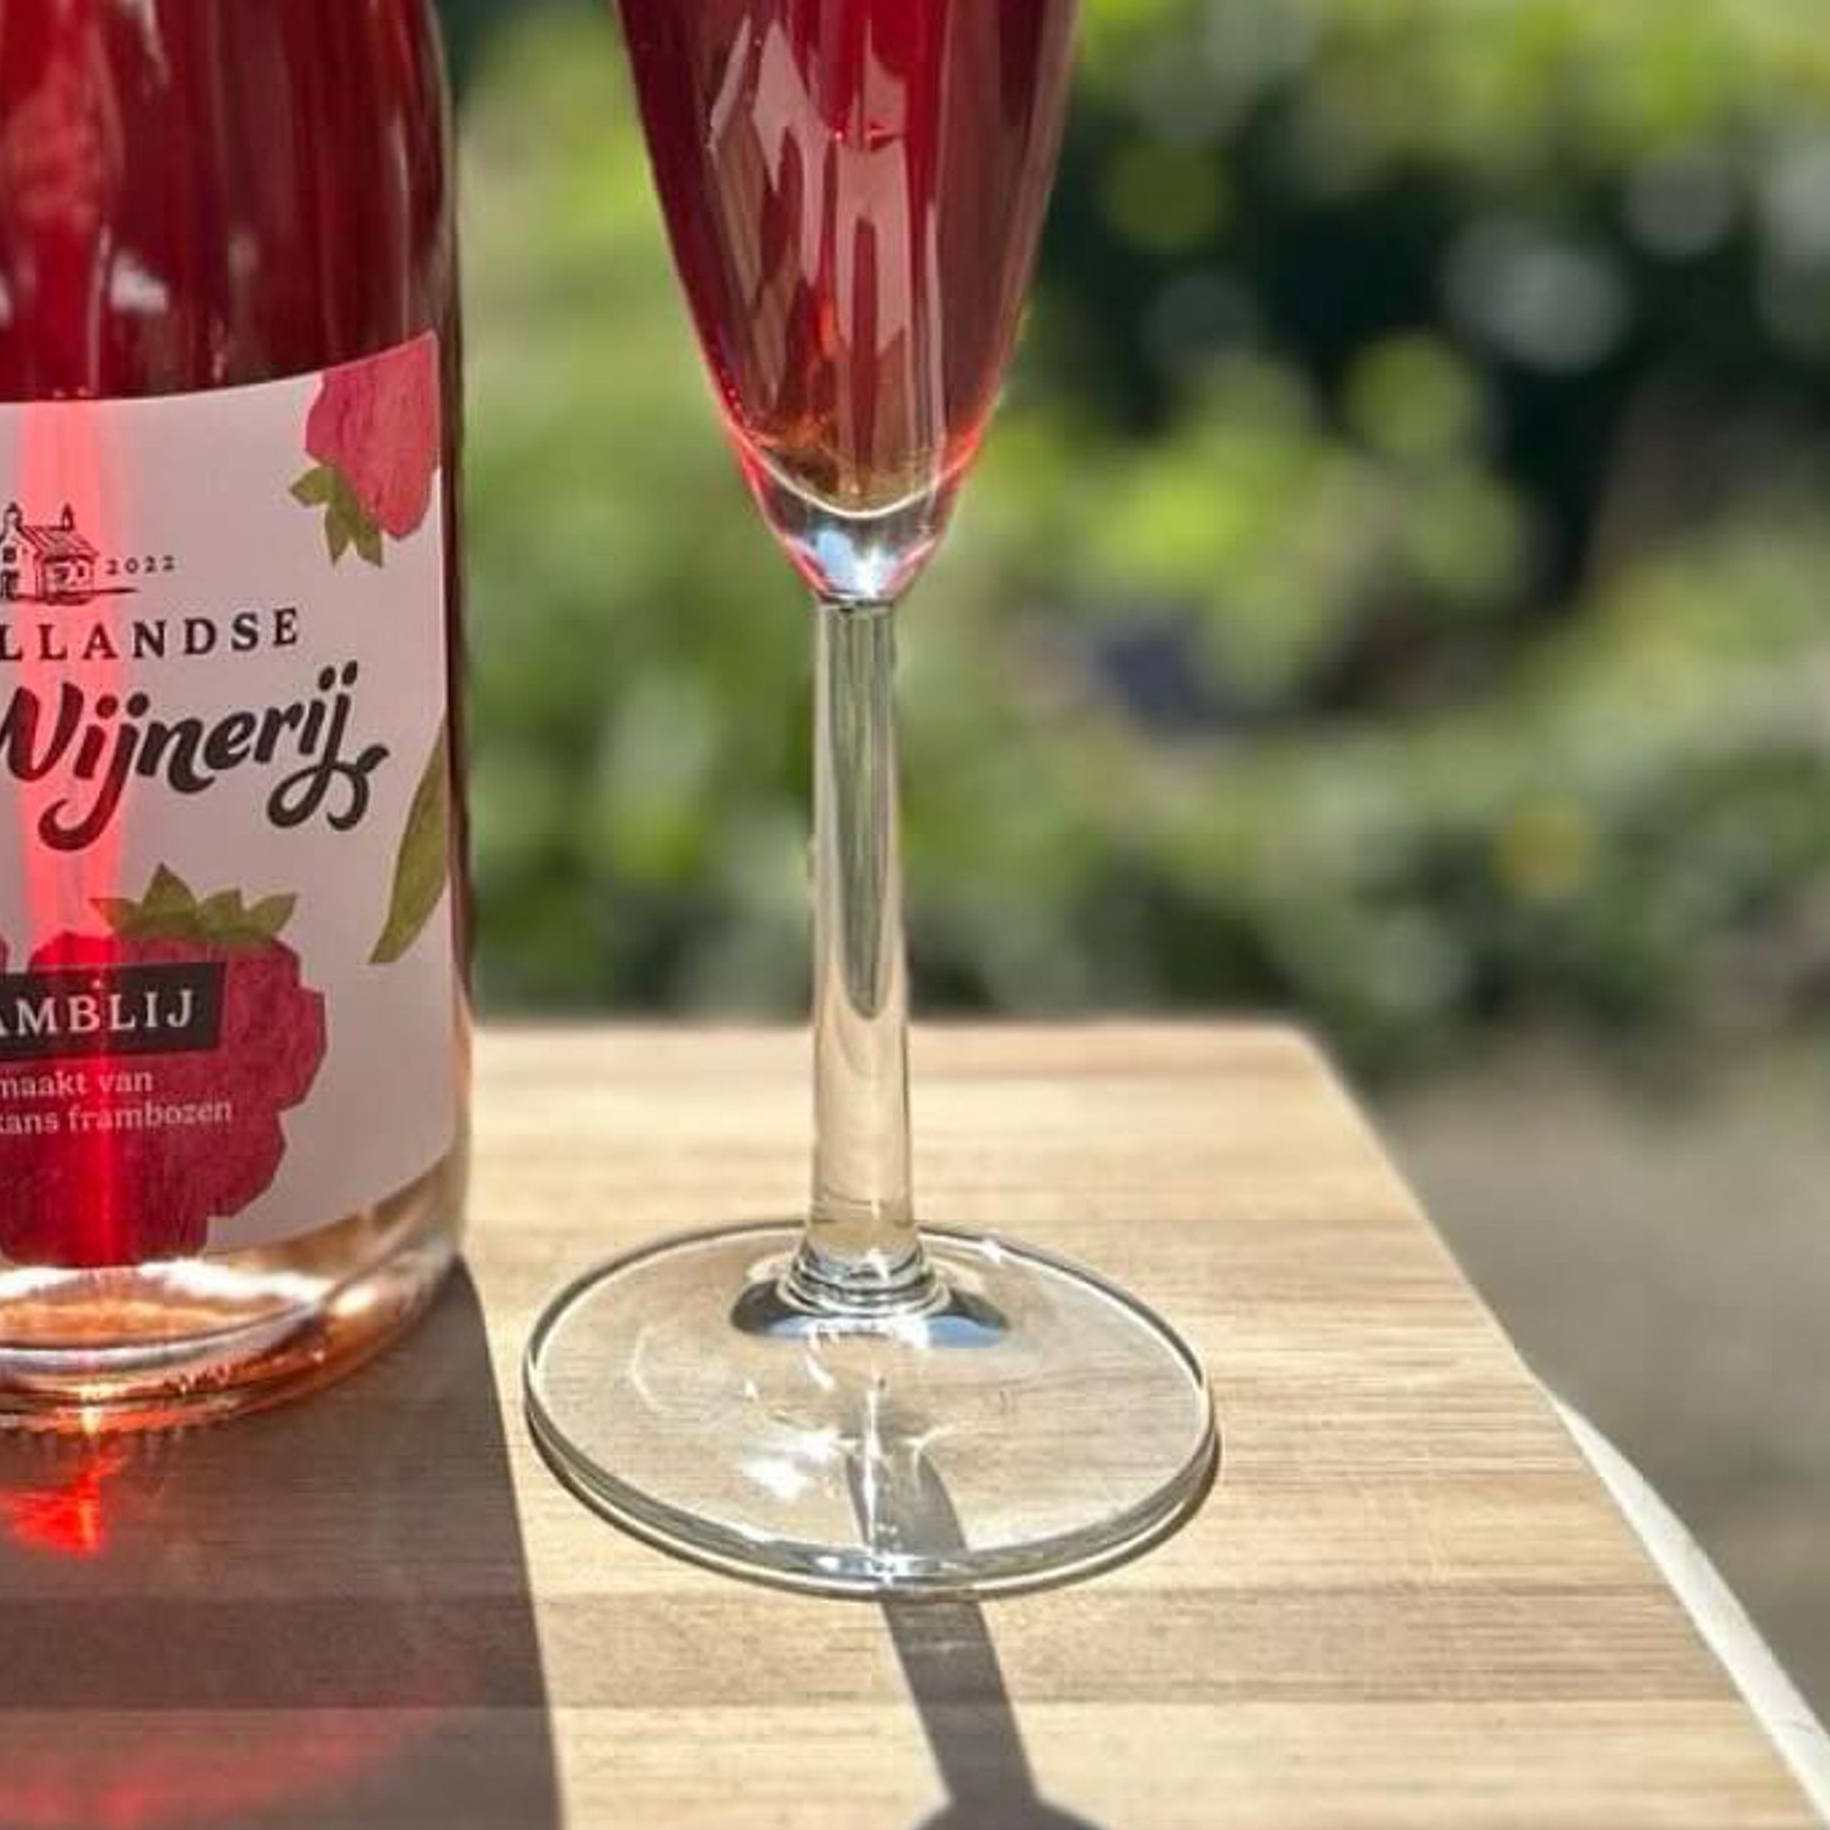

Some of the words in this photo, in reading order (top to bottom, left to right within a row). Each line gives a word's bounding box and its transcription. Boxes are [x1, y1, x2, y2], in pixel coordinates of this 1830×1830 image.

[106, 555, 177, 574] 2022
[97, 1070, 153, 1094] van
[68, 1098, 232, 1132] frambozen
